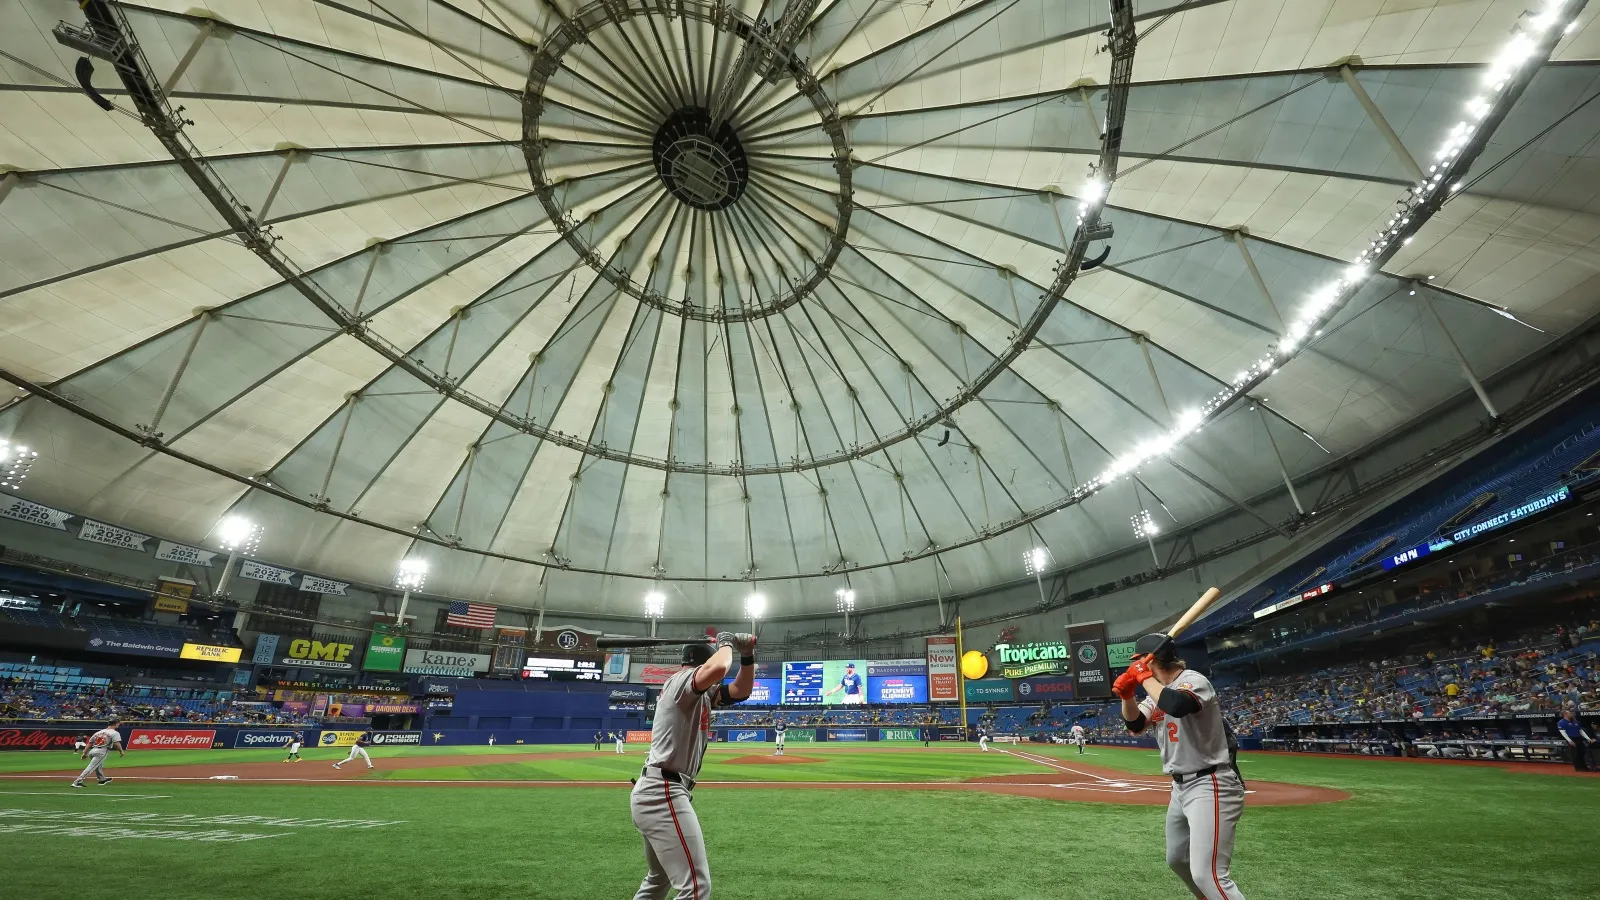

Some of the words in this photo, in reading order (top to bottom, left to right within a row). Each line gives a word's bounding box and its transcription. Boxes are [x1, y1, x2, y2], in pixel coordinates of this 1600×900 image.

[10, 504, 49, 520] 2020
[1453, 530, 1470, 542] CITY
[1471, 514, 1509, 534] CONNECT
[1510, 490, 1567, 519] SATURDAYS
[84, 533, 139, 549] CHAMPIONS
[96, 529, 132, 542] 2020
[160, 553, 207, 565] CHAMPIONS
[171, 548, 198, 559] 2021
[1407, 549, 1418, 560] PM
[245, 571, 264, 579] WILD
[265, 575, 287, 583] CARD
[254, 567, 281, 578] 2022
[312, 581, 336, 590] 2023
[262, 636, 275, 644] 42
[106, 640, 122, 648] The
[122, 642, 155, 650] Baldwin
[155, 645, 180, 653] Group
[196, 645, 229, 654] REPUBLIC
[289, 639, 355, 662] GMF
[1109, 646, 1135, 656] AUD
[421, 651, 477, 667] kanes
[929, 654, 954, 663] New
[995, 643, 1067, 664] Tropicana
[1004, 668, 1024, 676] PURE
[1024, 662, 1059, 674] PREMIUM
[1079, 675, 1104, 683] AMERICAS
[1035, 683, 1072, 692] BOSCH
[375, 705, 400, 713] DAIQUIRI
[893, 730, 915, 739] RIPA
[1167, 722, 1179, 742] 2
[0, 729, 56, 750] Bally
[244, 734, 292, 745] Spectrum
